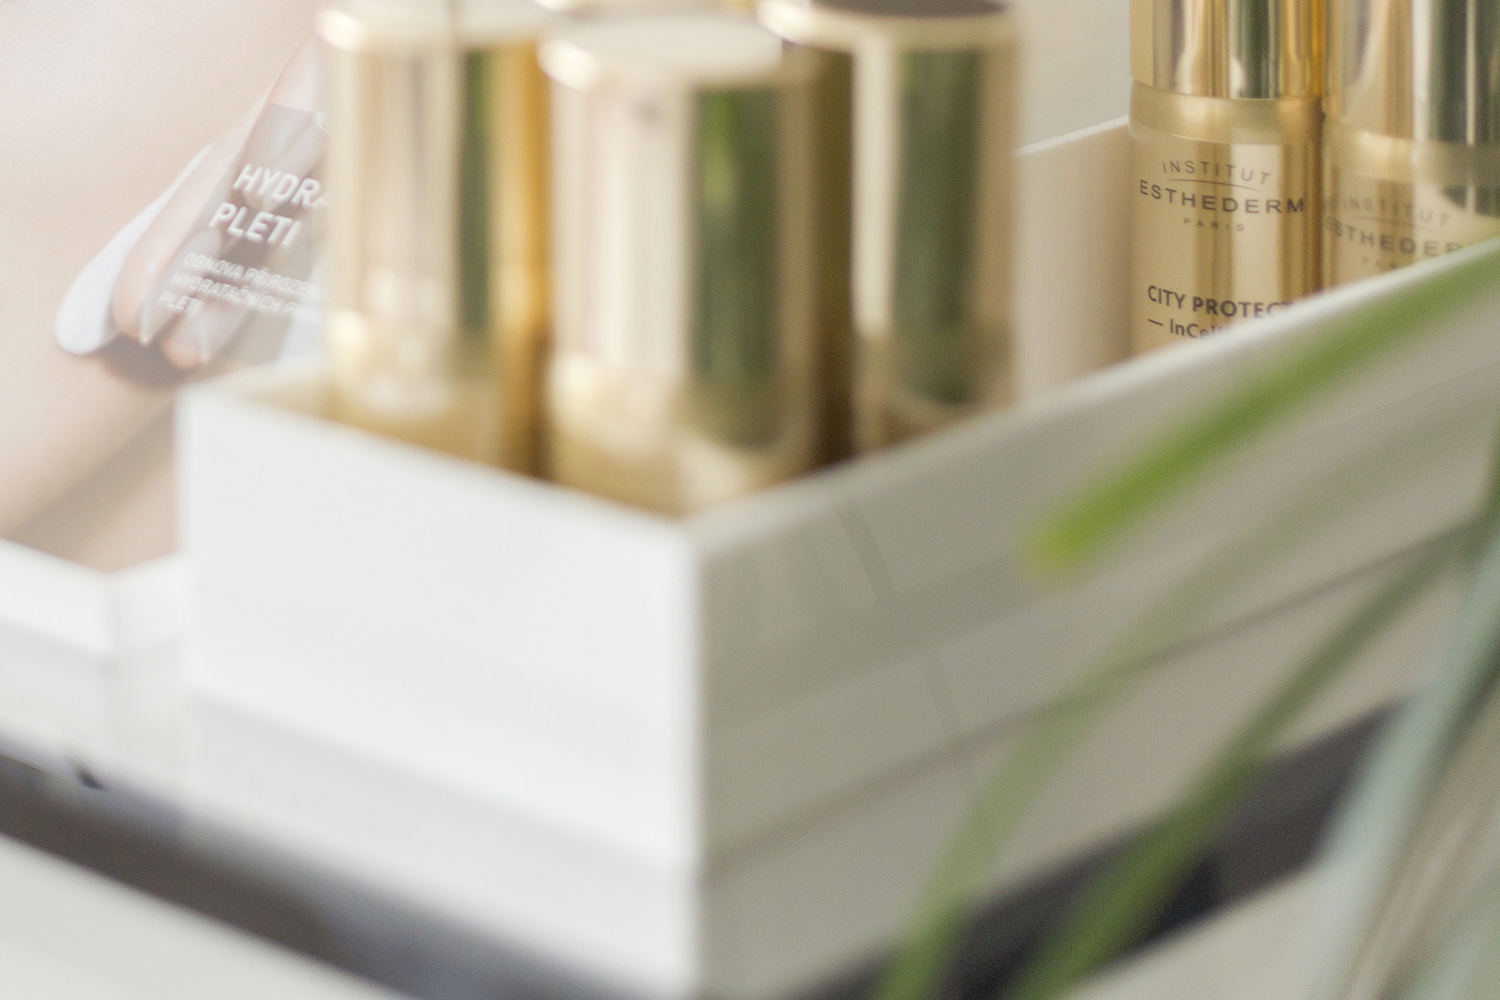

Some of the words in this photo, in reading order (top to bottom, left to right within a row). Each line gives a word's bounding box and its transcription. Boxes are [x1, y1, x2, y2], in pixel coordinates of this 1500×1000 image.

[232, 163, 322, 210] HYDR
[1161, 160, 1272, 186] INSTITUT
[1139, 179, 1306, 214] ESTHEDERM
[207, 201, 303, 247] PLETI
[1183, 217, 1245, 232] PARIS
[1147, 284, 1186, 310] CITY
